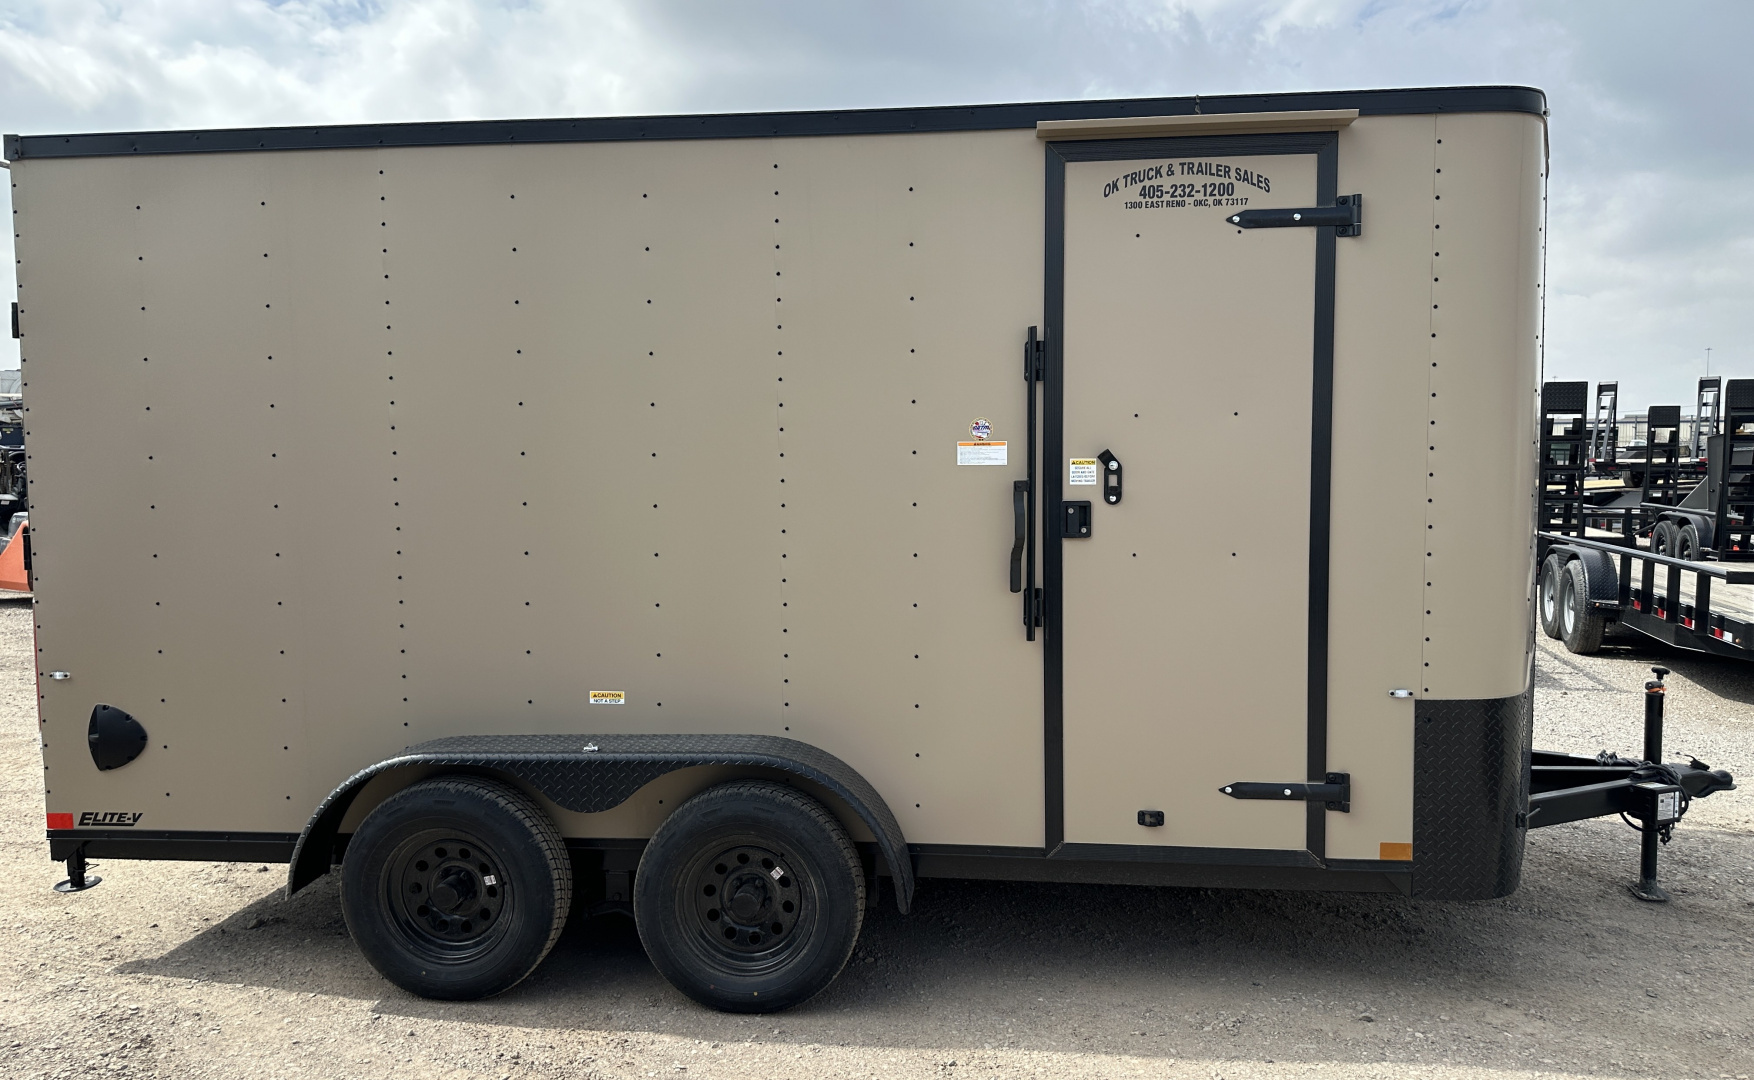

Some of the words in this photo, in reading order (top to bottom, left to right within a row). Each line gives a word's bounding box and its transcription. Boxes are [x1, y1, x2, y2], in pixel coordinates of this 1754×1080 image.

[1103, 178, 1119, 198] OK
[1123, 165, 1163, 188] TRUCK
[1166, 163, 1175, 177] &
[1179, 162, 1231, 179] TRAILER
[1234, 167, 1271, 193] SALES
[1139, 182, 1235, 199] 405-232-1200
[1124, 201, 1143, 209] 1300
[1145, 200, 1164, 208] EAST
[1166, 200, 1186, 208] RENO
[1193, 199, 1211, 208] OKC,
[1213, 199, 1223, 207] OK
[1225, 198, 1249, 206] 73117
[78, 812, 143, 826] ELITE-V
